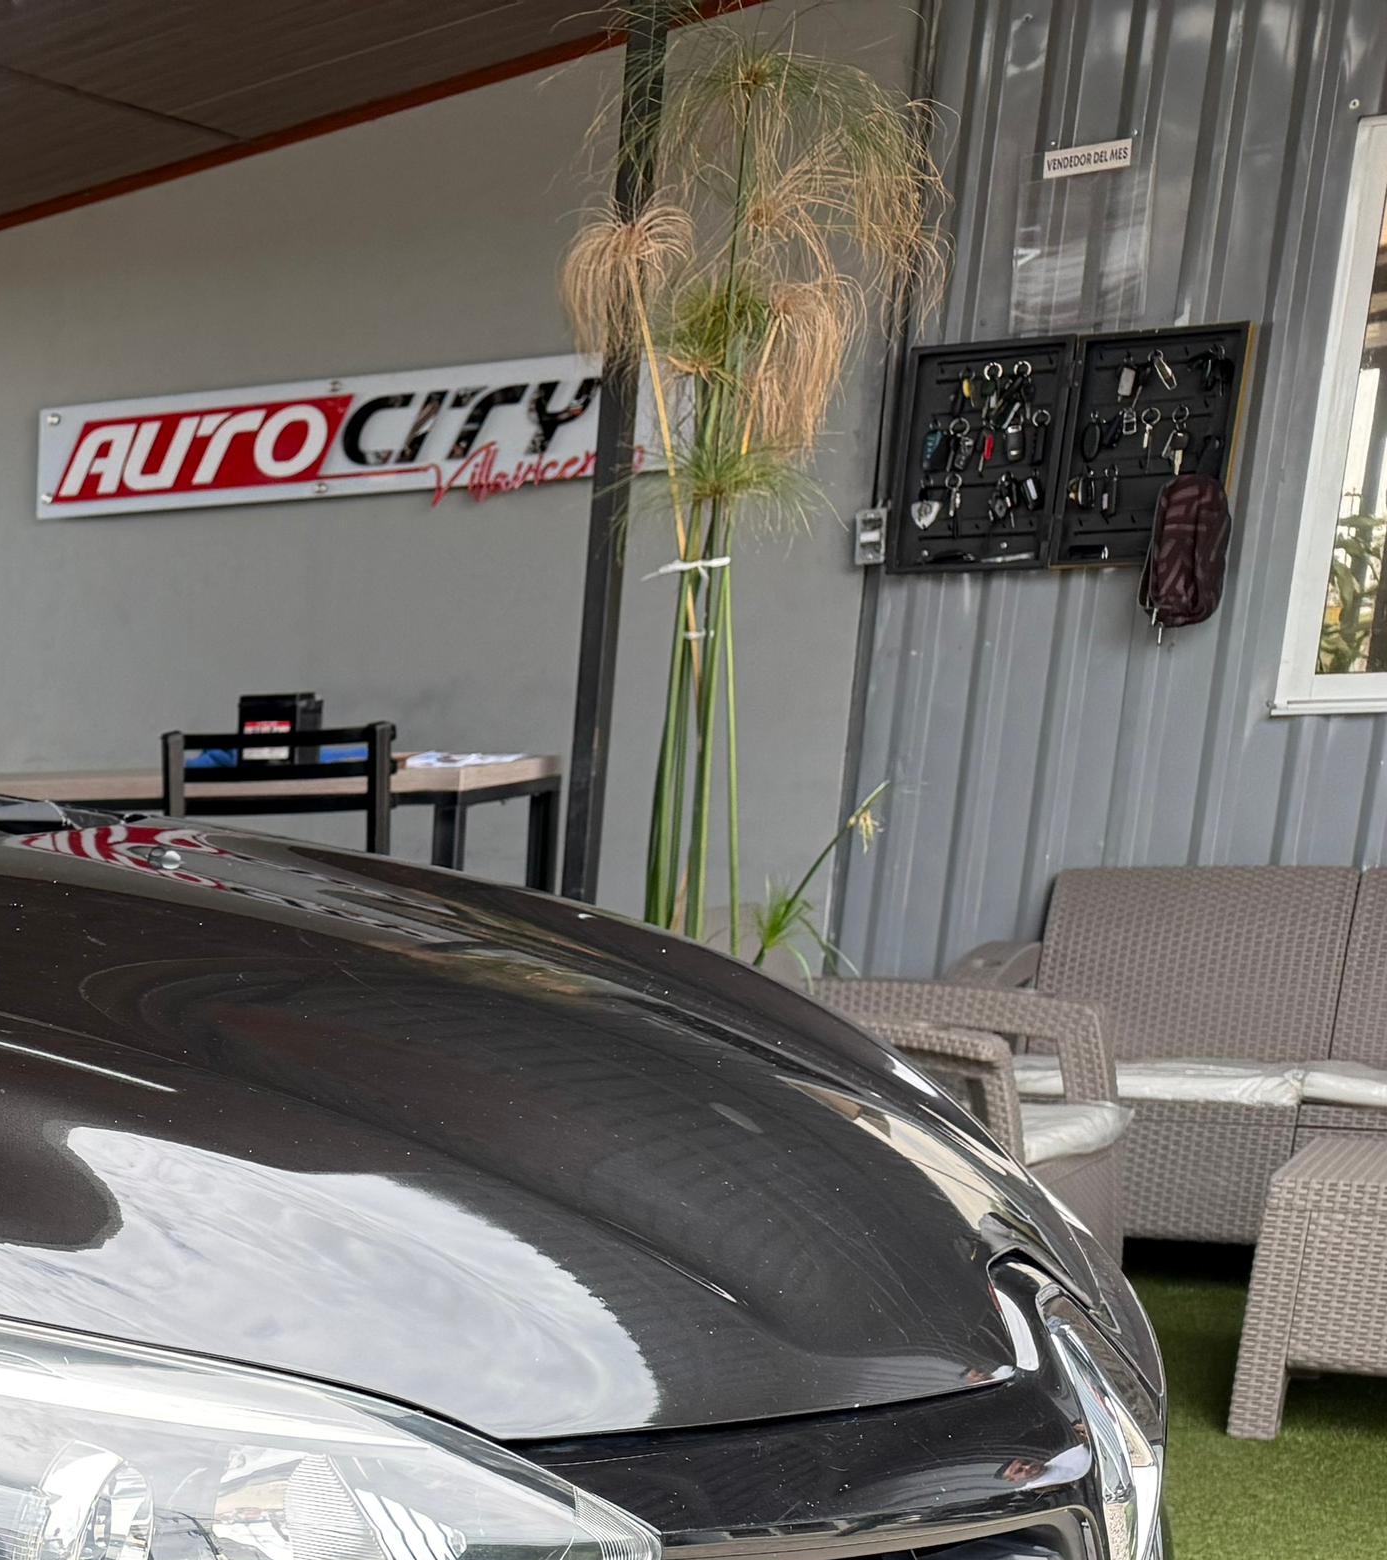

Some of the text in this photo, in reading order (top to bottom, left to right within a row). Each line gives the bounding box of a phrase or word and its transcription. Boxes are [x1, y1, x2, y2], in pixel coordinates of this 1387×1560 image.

[1047, 147, 1128, 171] VENDEDOR DEL MES
